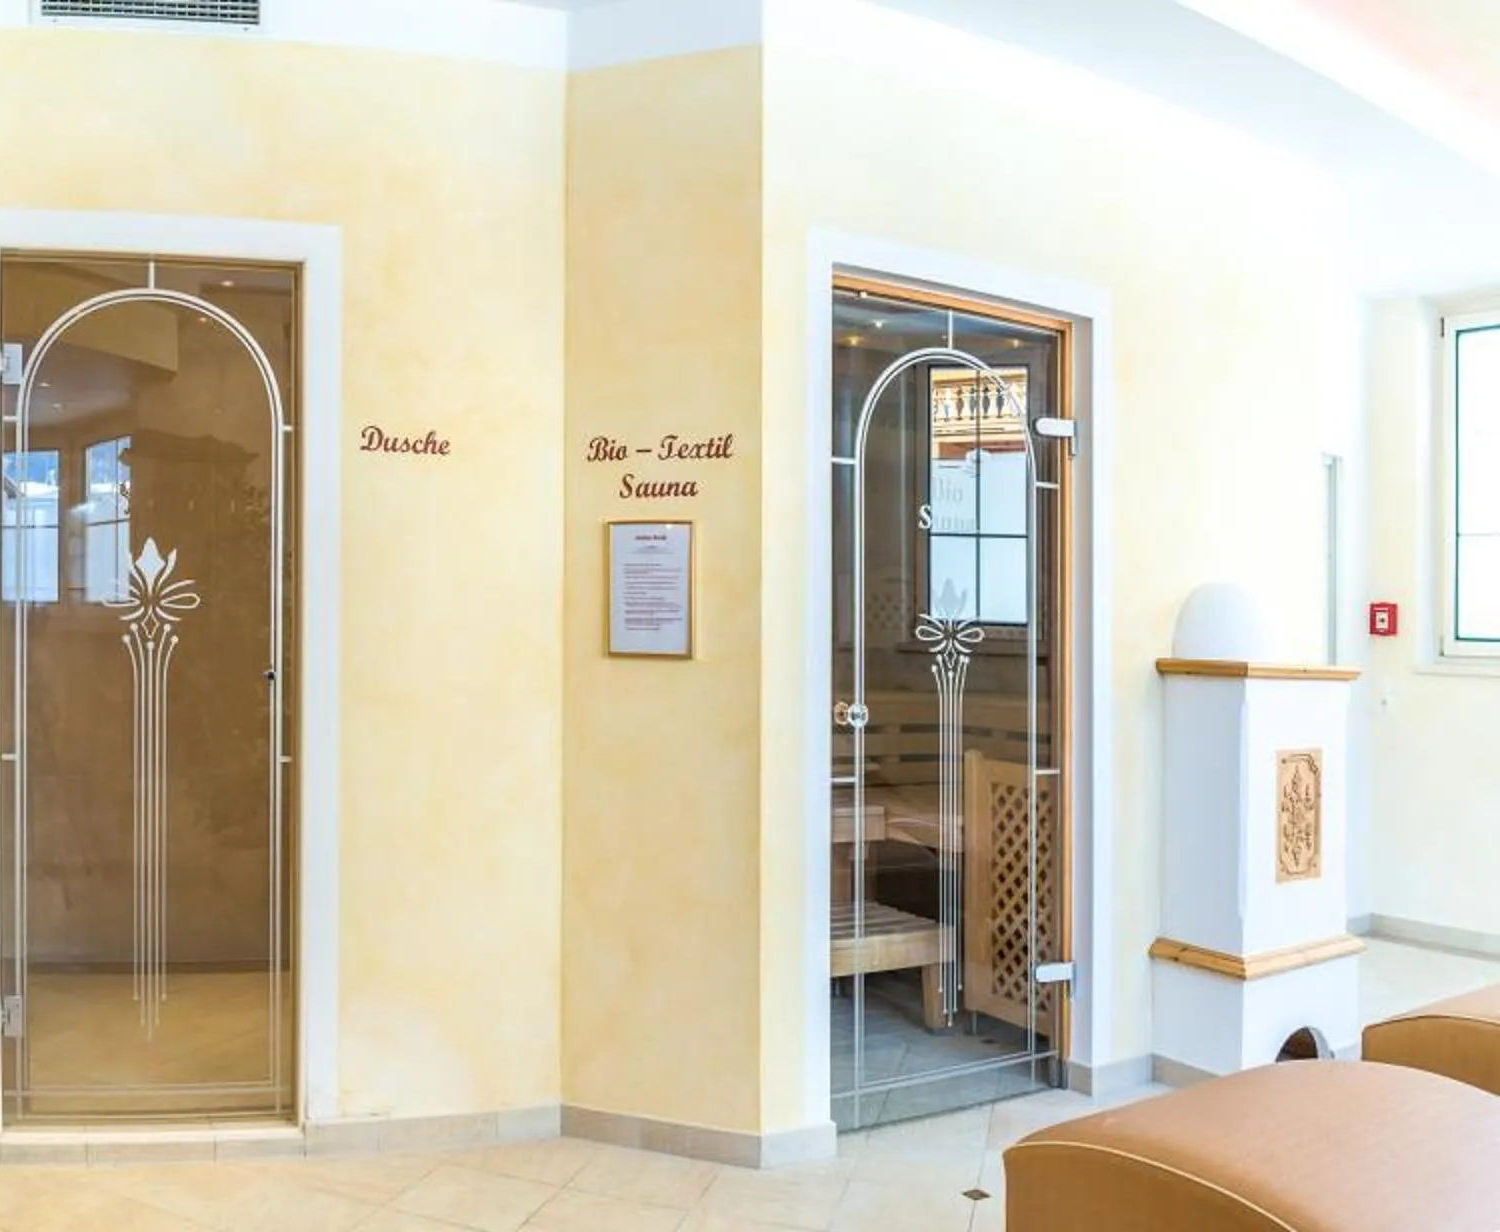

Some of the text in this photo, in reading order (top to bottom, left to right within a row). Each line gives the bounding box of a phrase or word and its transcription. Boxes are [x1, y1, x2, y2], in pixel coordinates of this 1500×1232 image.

[359, 425, 451, 456] Dusche
[586, 435, 628, 462] Bio
[657, 433, 733, 461] Textil
[618, 473, 699, 499] Sauna
